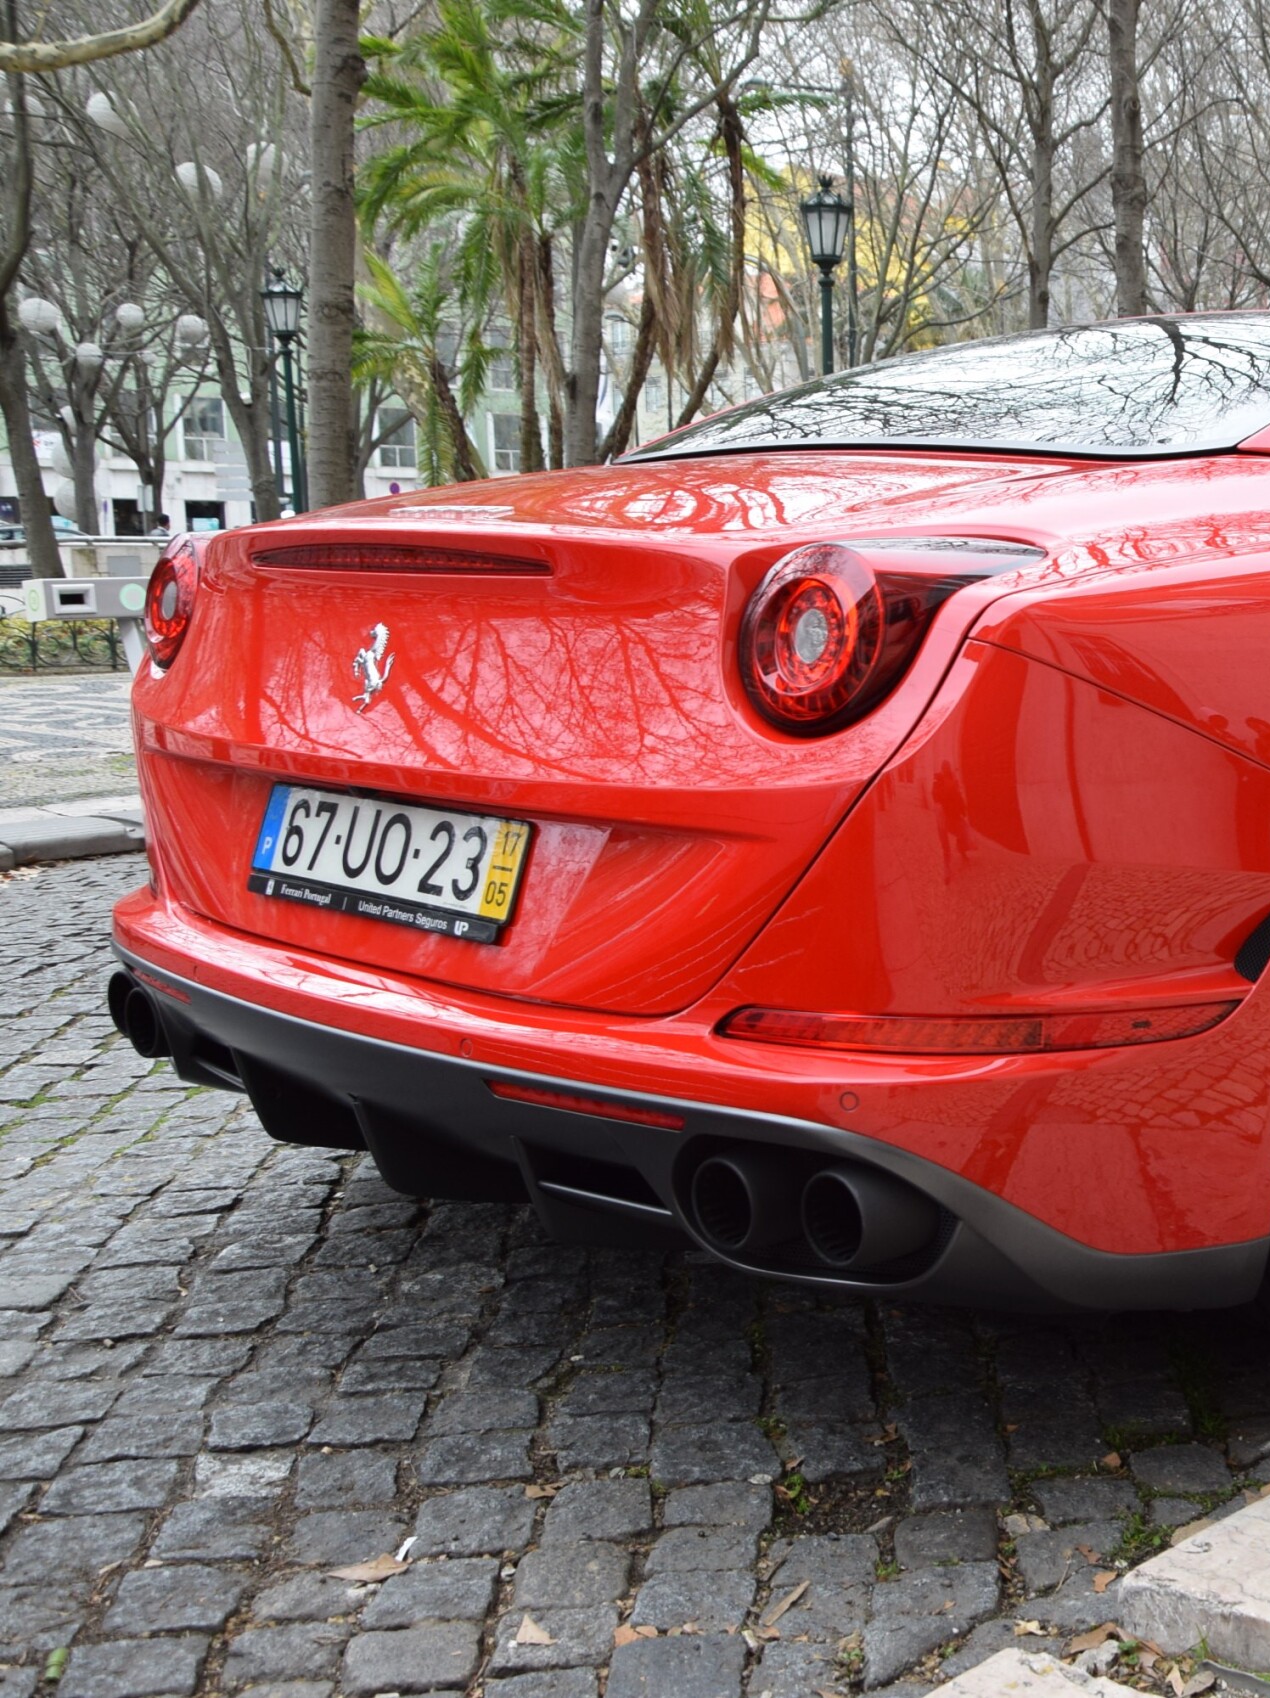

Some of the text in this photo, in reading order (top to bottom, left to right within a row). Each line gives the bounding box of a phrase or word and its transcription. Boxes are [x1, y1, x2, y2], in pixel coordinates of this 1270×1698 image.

[262, 836, 273, 854] P
[500, 830, 521, 858] 17
[280, 883, 332, 906] Ferrari Portugal
[484, 880, 509, 907] 05
[358, 900, 382, 916] United
[382, 905, 414, 922] Partners
[415, 912, 448, 930] Seguros
